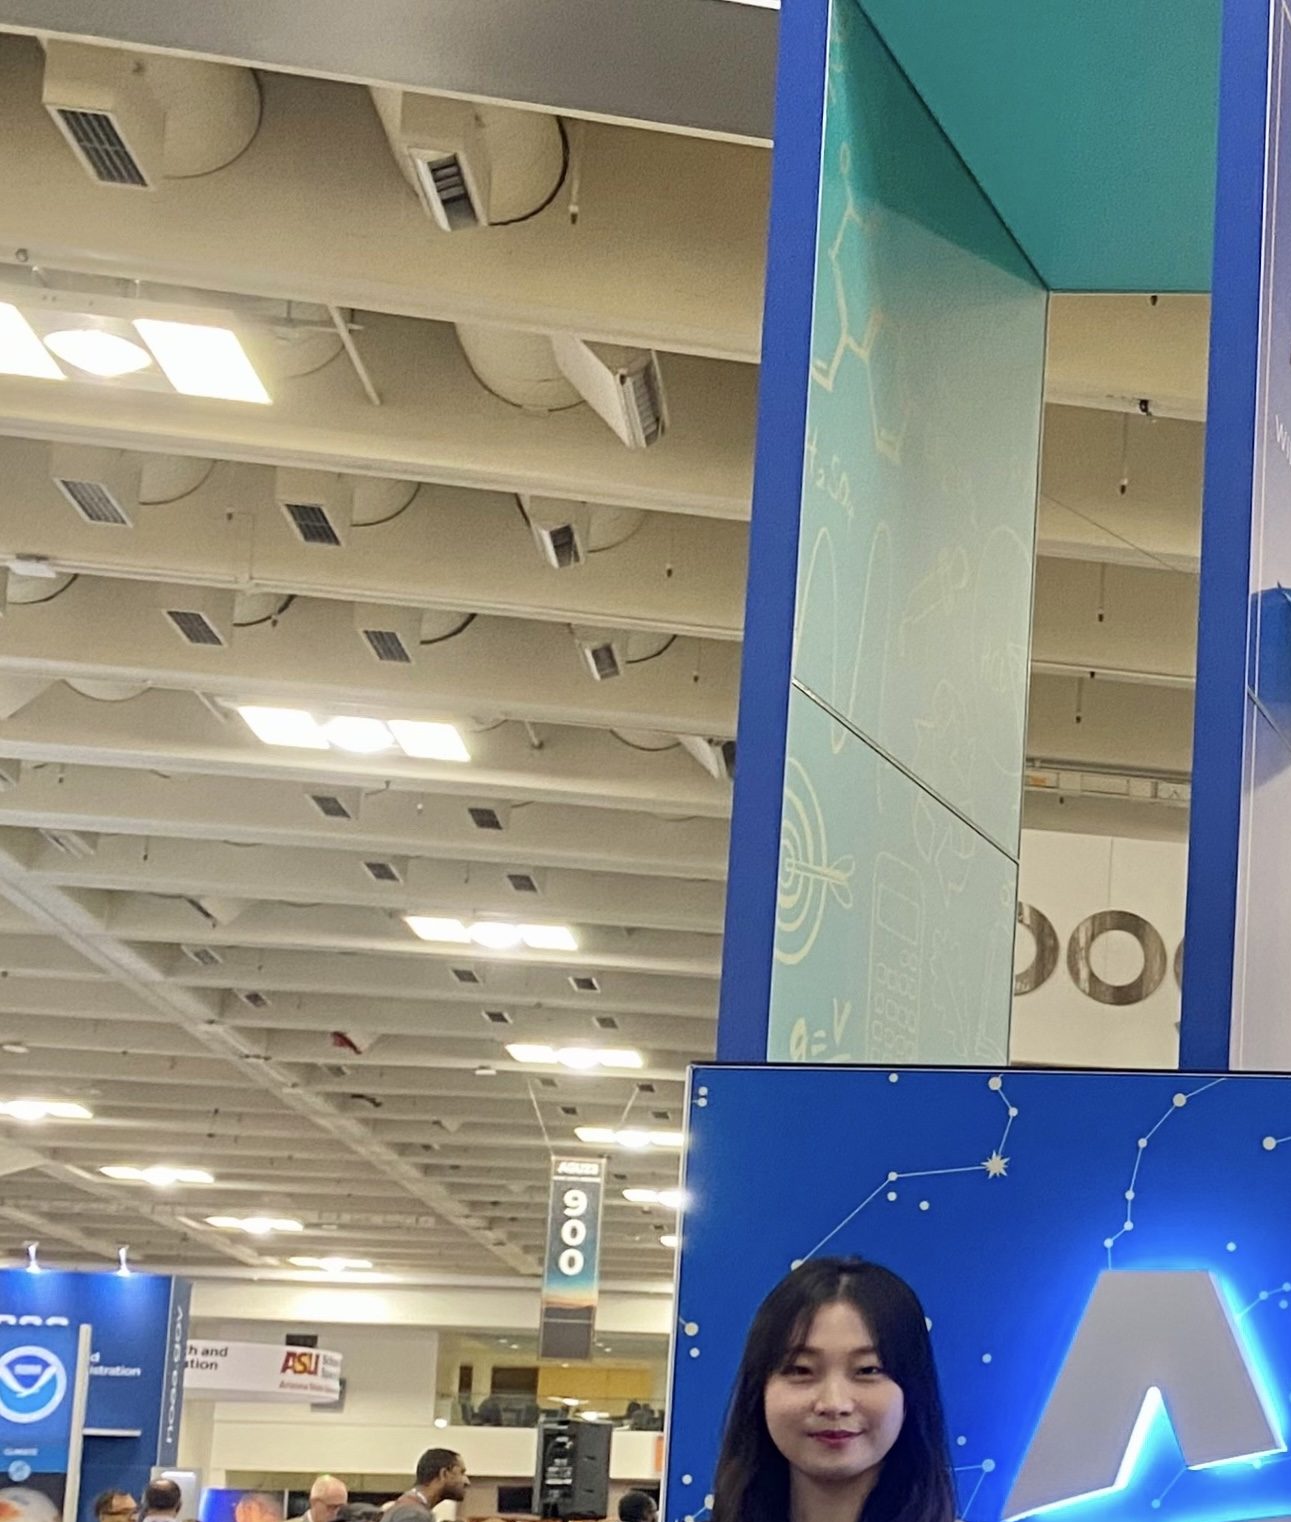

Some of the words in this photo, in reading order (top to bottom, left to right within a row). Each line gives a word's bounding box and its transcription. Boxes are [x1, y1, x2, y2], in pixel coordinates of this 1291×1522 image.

[558, 1188, 589, 1276] 900
[201, 1346, 229, 1358] and
[89, 1365, 142, 1377] istration
[280, 1350, 320, 1376] ASU
